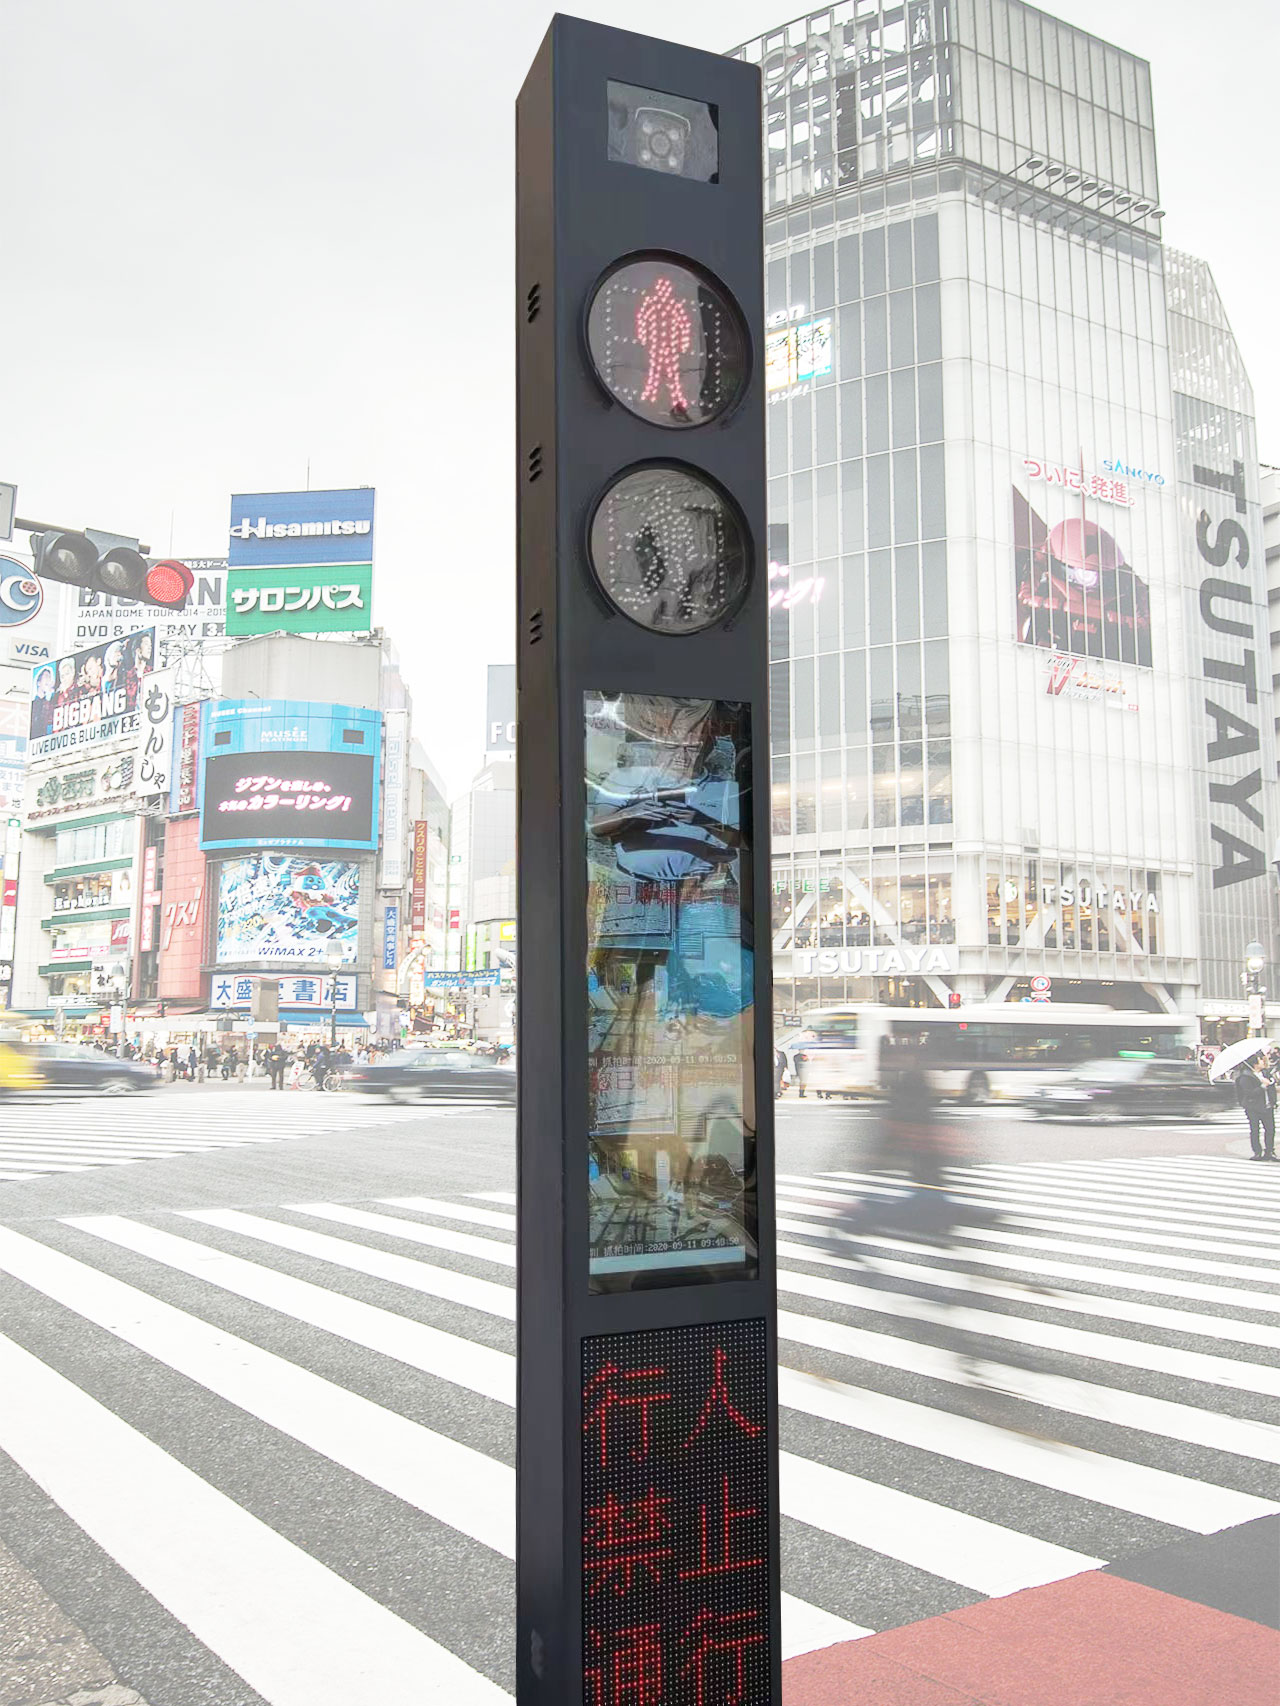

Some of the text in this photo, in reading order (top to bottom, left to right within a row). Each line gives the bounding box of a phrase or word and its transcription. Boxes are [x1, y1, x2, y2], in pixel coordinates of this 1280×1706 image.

[1023, 458, 1136, 507] ついに、発進。
[1103, 459, 1165, 487] SANKYO
[229, 517, 370, 538] Hisamitsu
[116, 609, 143, 617] DOME
[232, 584, 363, 613] サロンパス
[77, 626, 107, 637] DVD
[114, 625, 123, 637] &
[15, 643, 49, 658] VISA
[1193, 459, 1267, 890] TSUTAYA
[53, 688, 127, 732] BIGBANG
[32, 740, 49, 756] LIVE
[50, 734, 68, 750] DVD
[70, 733, 77, 746] &
[79, 720, 119, 743] BLU-RAY
[140, 683, 169, 791] もんじゃ
[1042, 884, 1159, 913] TSUTAYA
[164, 885, 204, 951] クスリ
[258, 947, 306, 957] WiMAX
[797, 948, 950, 974] TSUTAYA
[582, 1344, 767, 1469] 行人
[582, 1471, 766, 1598] 禁止
